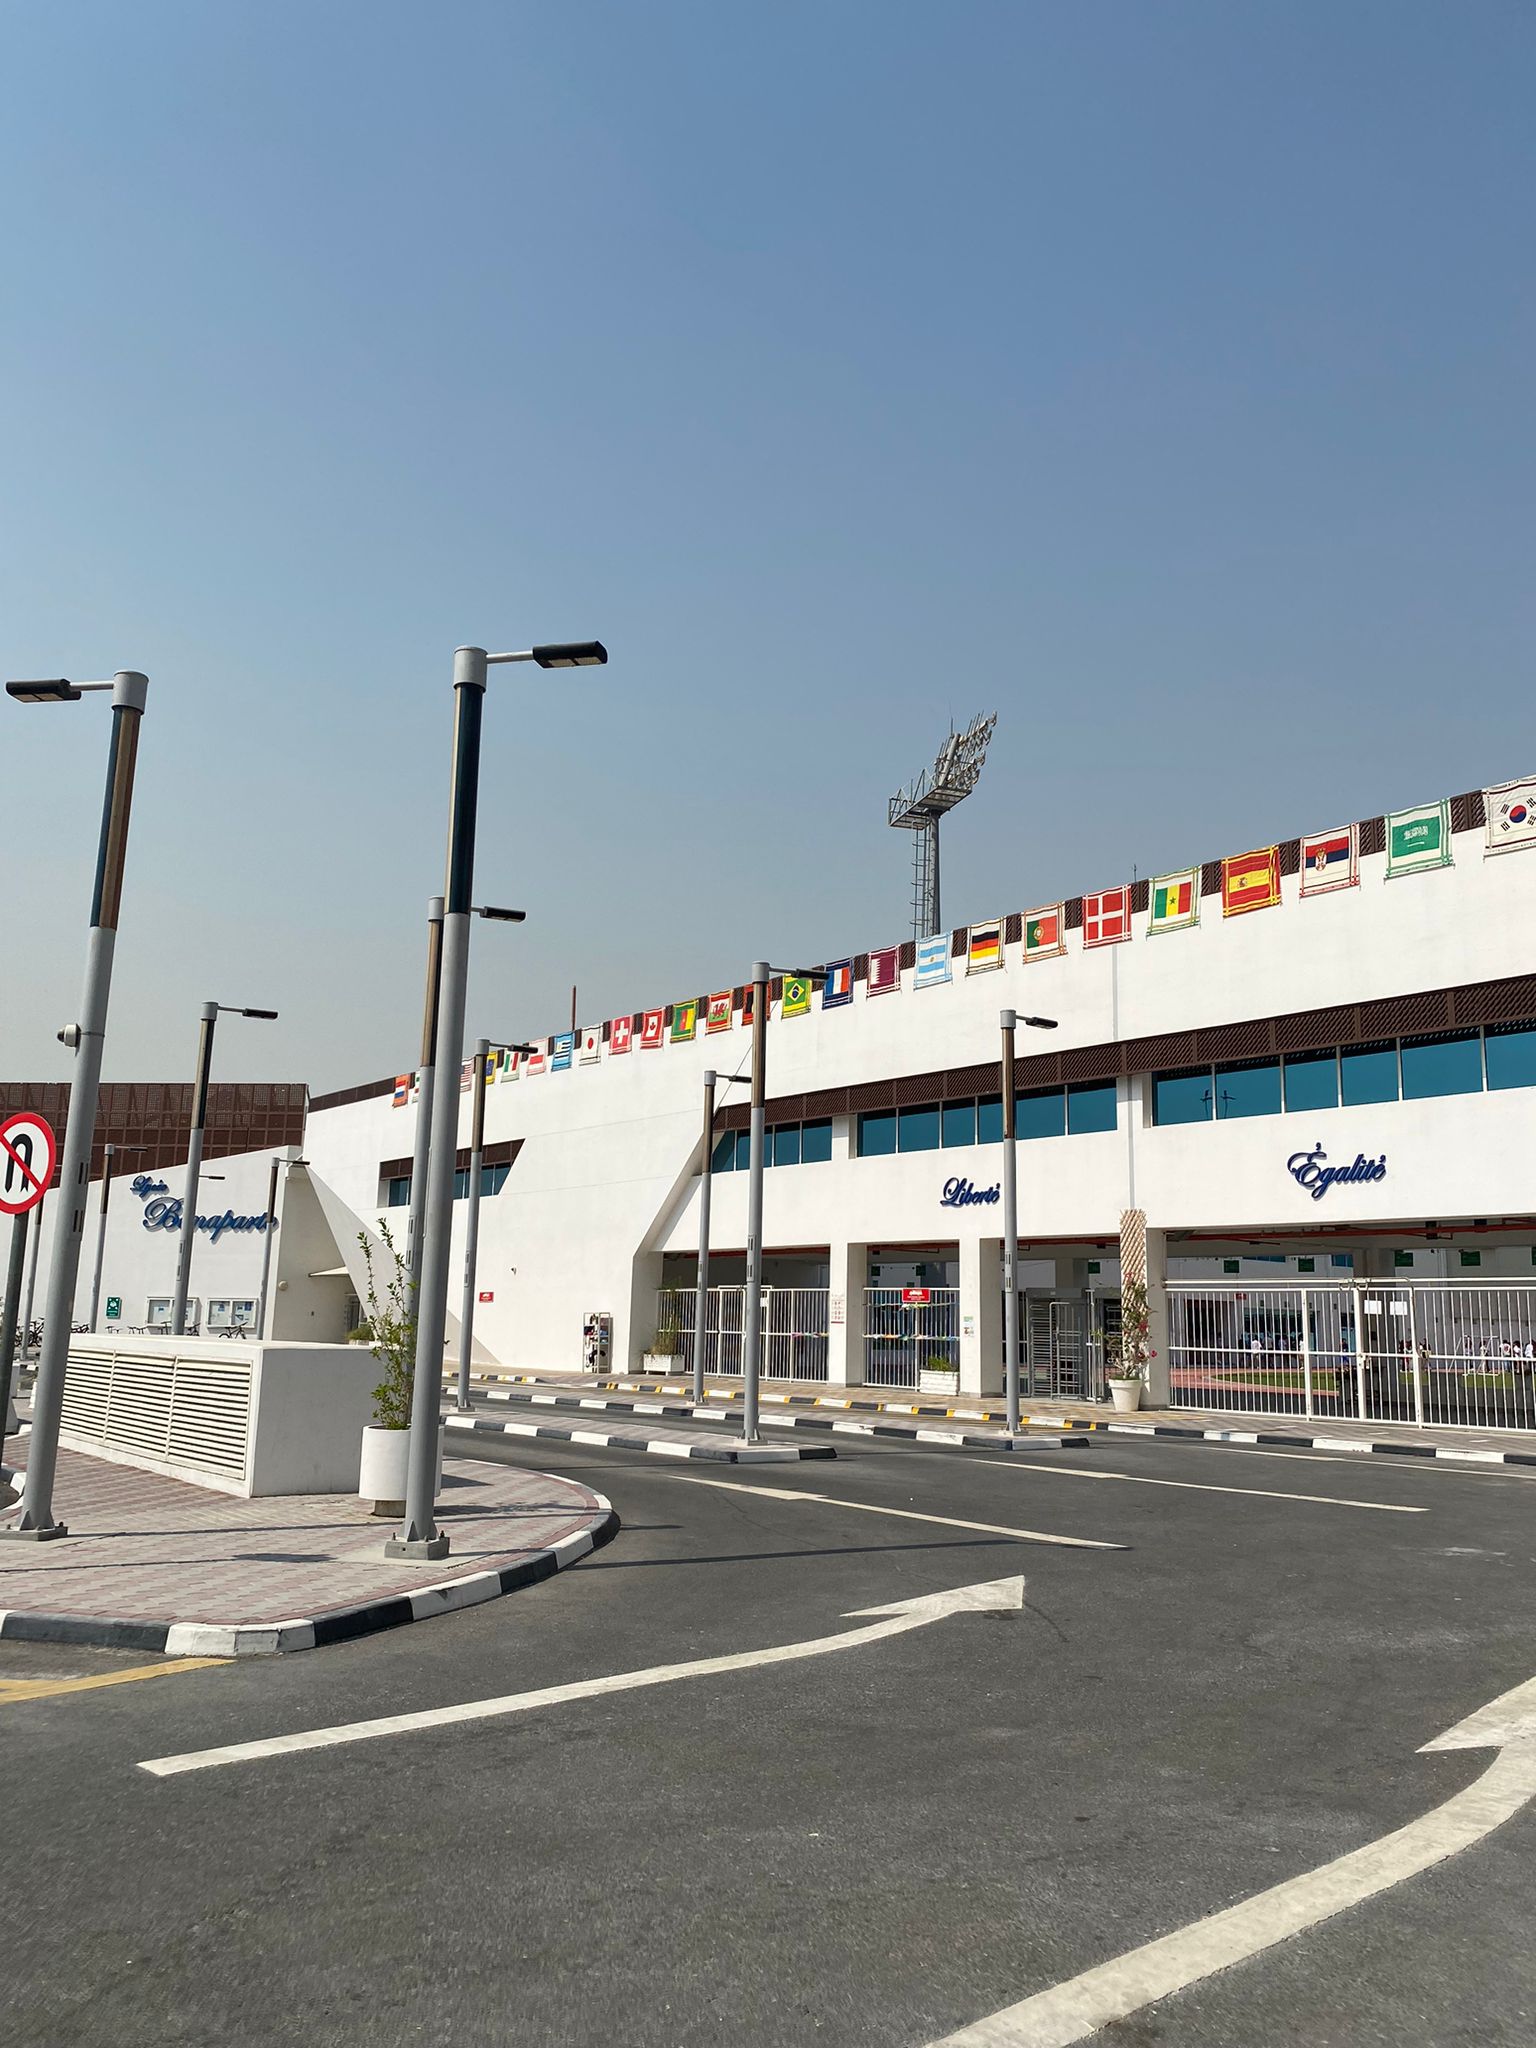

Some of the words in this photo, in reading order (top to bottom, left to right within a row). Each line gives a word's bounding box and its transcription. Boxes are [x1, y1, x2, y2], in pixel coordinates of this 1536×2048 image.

[940, 1177, 1000, 1206] Liberté
[1287, 1142, 1386, 1199] Égalité
[143, 1196, 278, 1241] Bnapart
